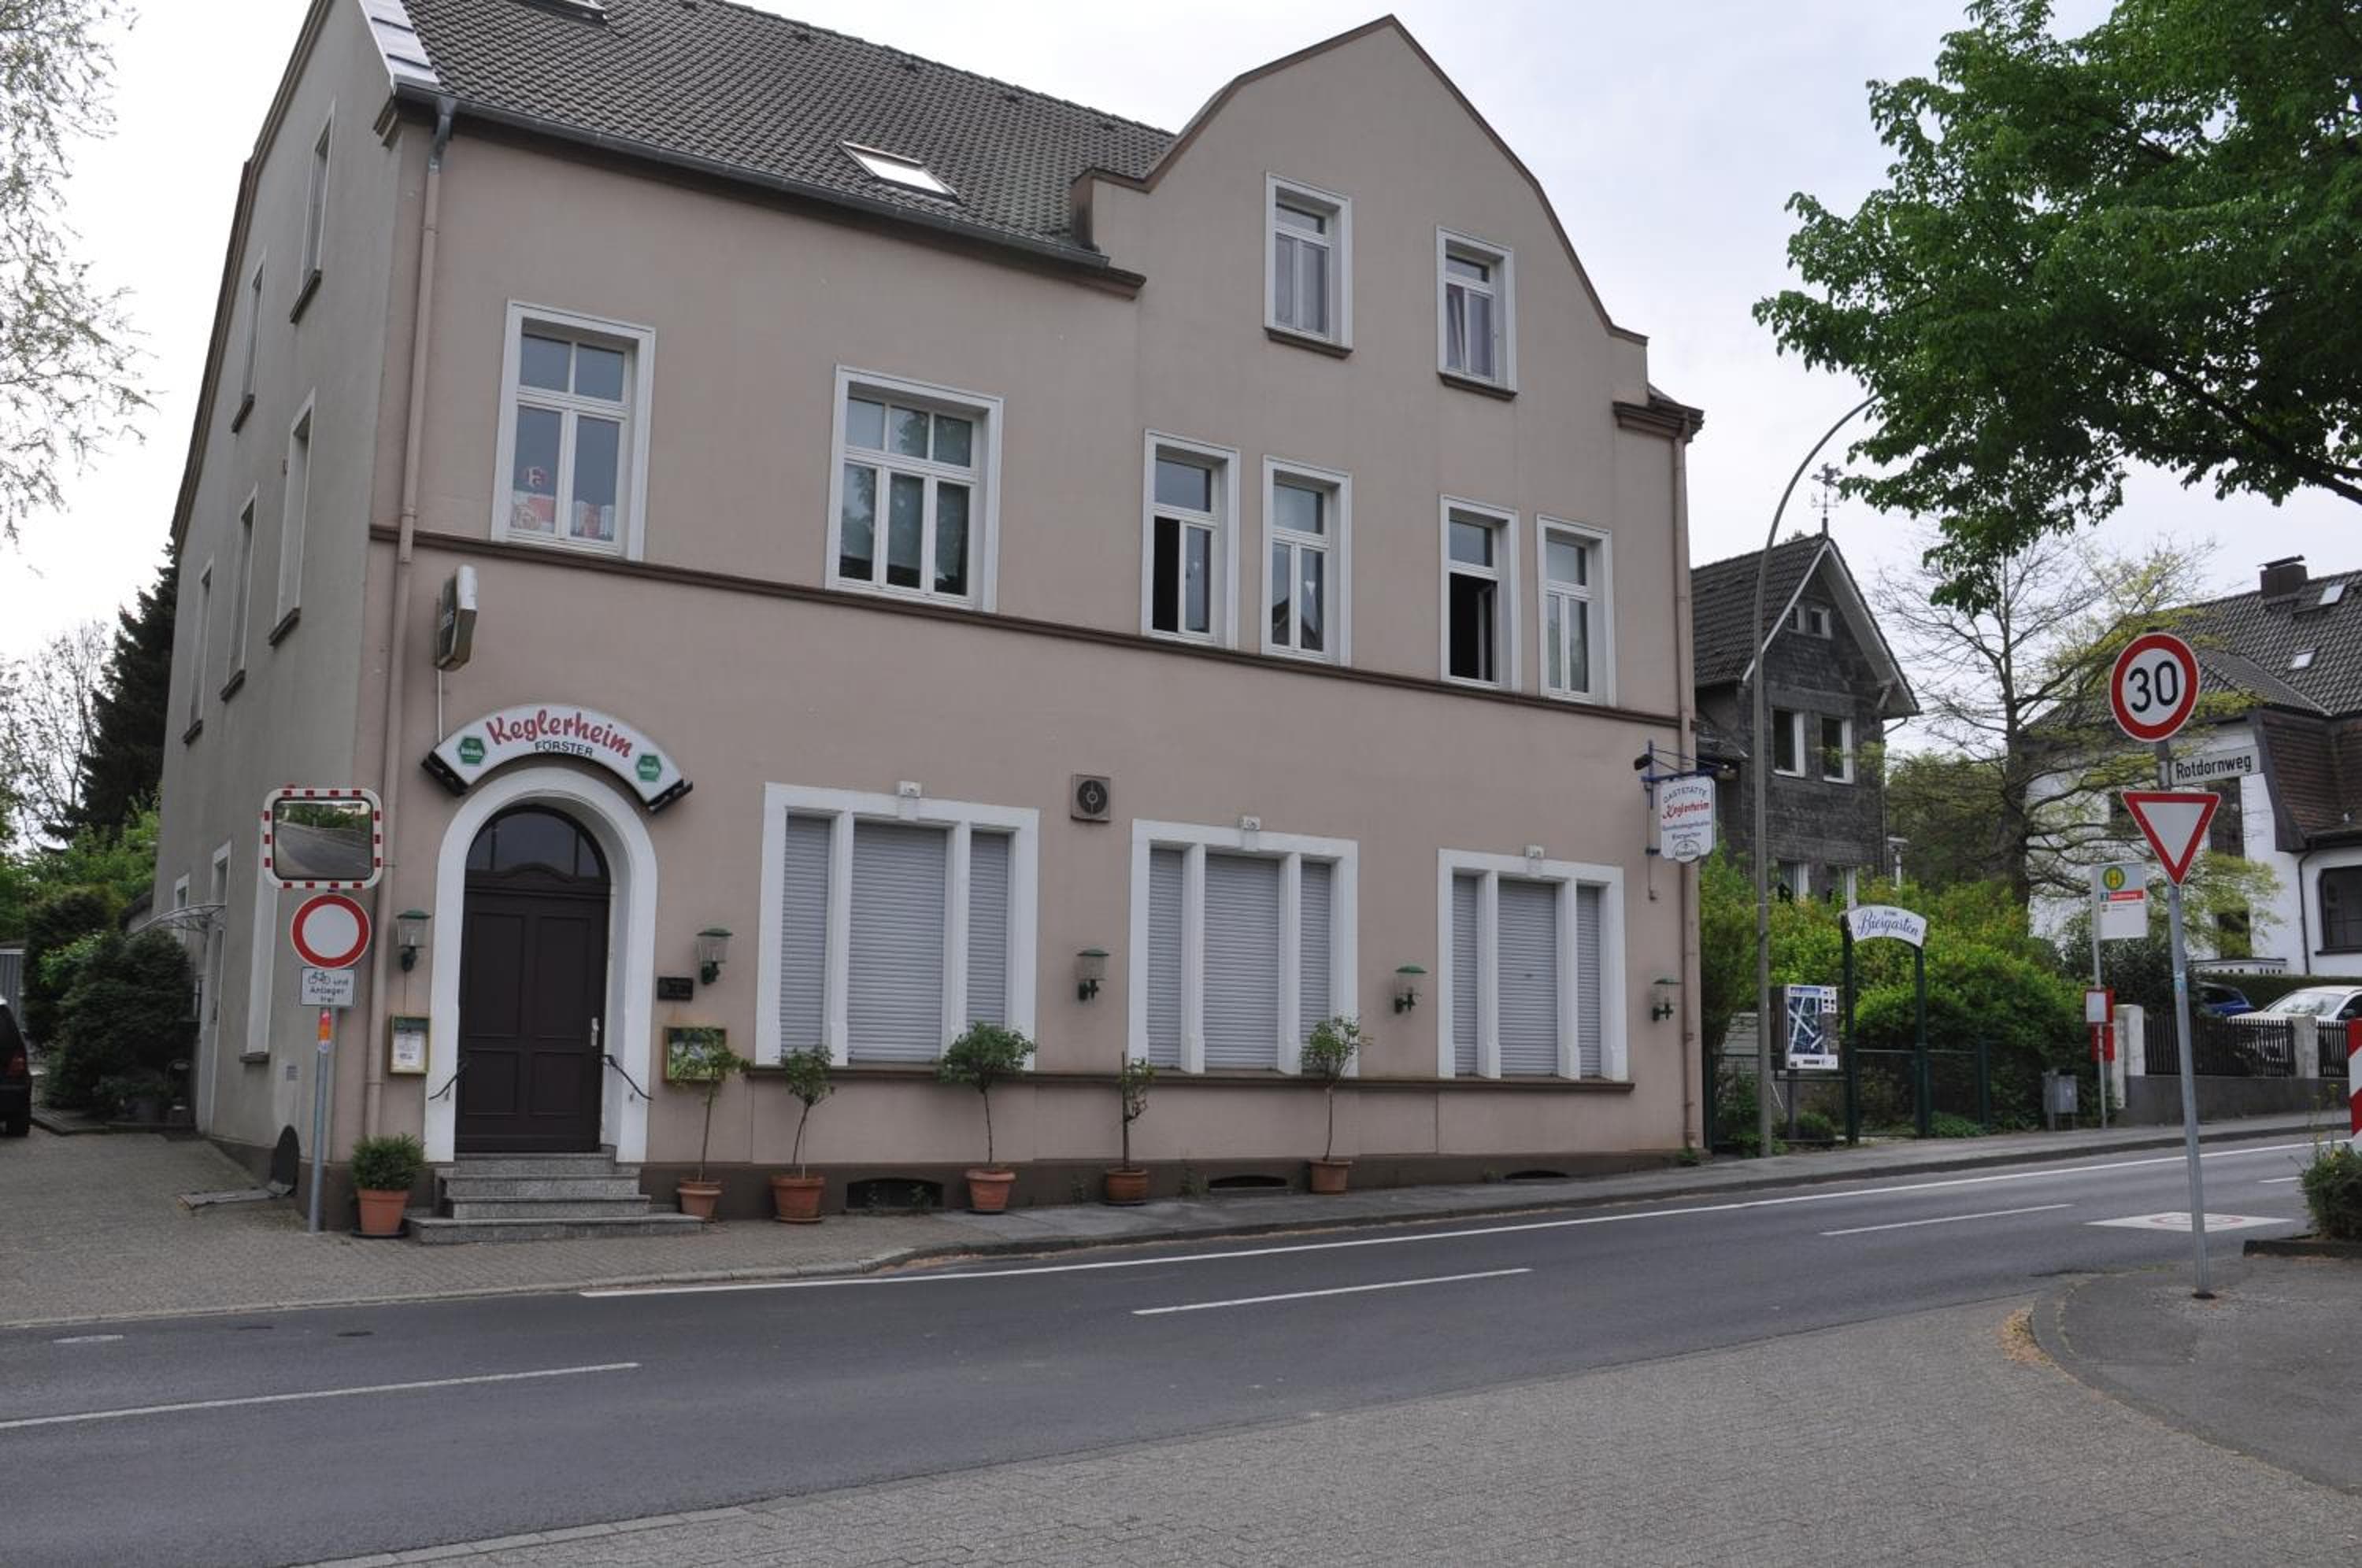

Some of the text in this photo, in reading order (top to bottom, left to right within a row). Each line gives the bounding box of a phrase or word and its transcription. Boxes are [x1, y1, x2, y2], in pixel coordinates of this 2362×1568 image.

[2129, 660, 2179, 712] 30
[486, 709, 632, 758] Keglerheim
[535, 739, 594, 757] FÖRSTER
[2175, 755, 2253, 779] Rotdornweg
